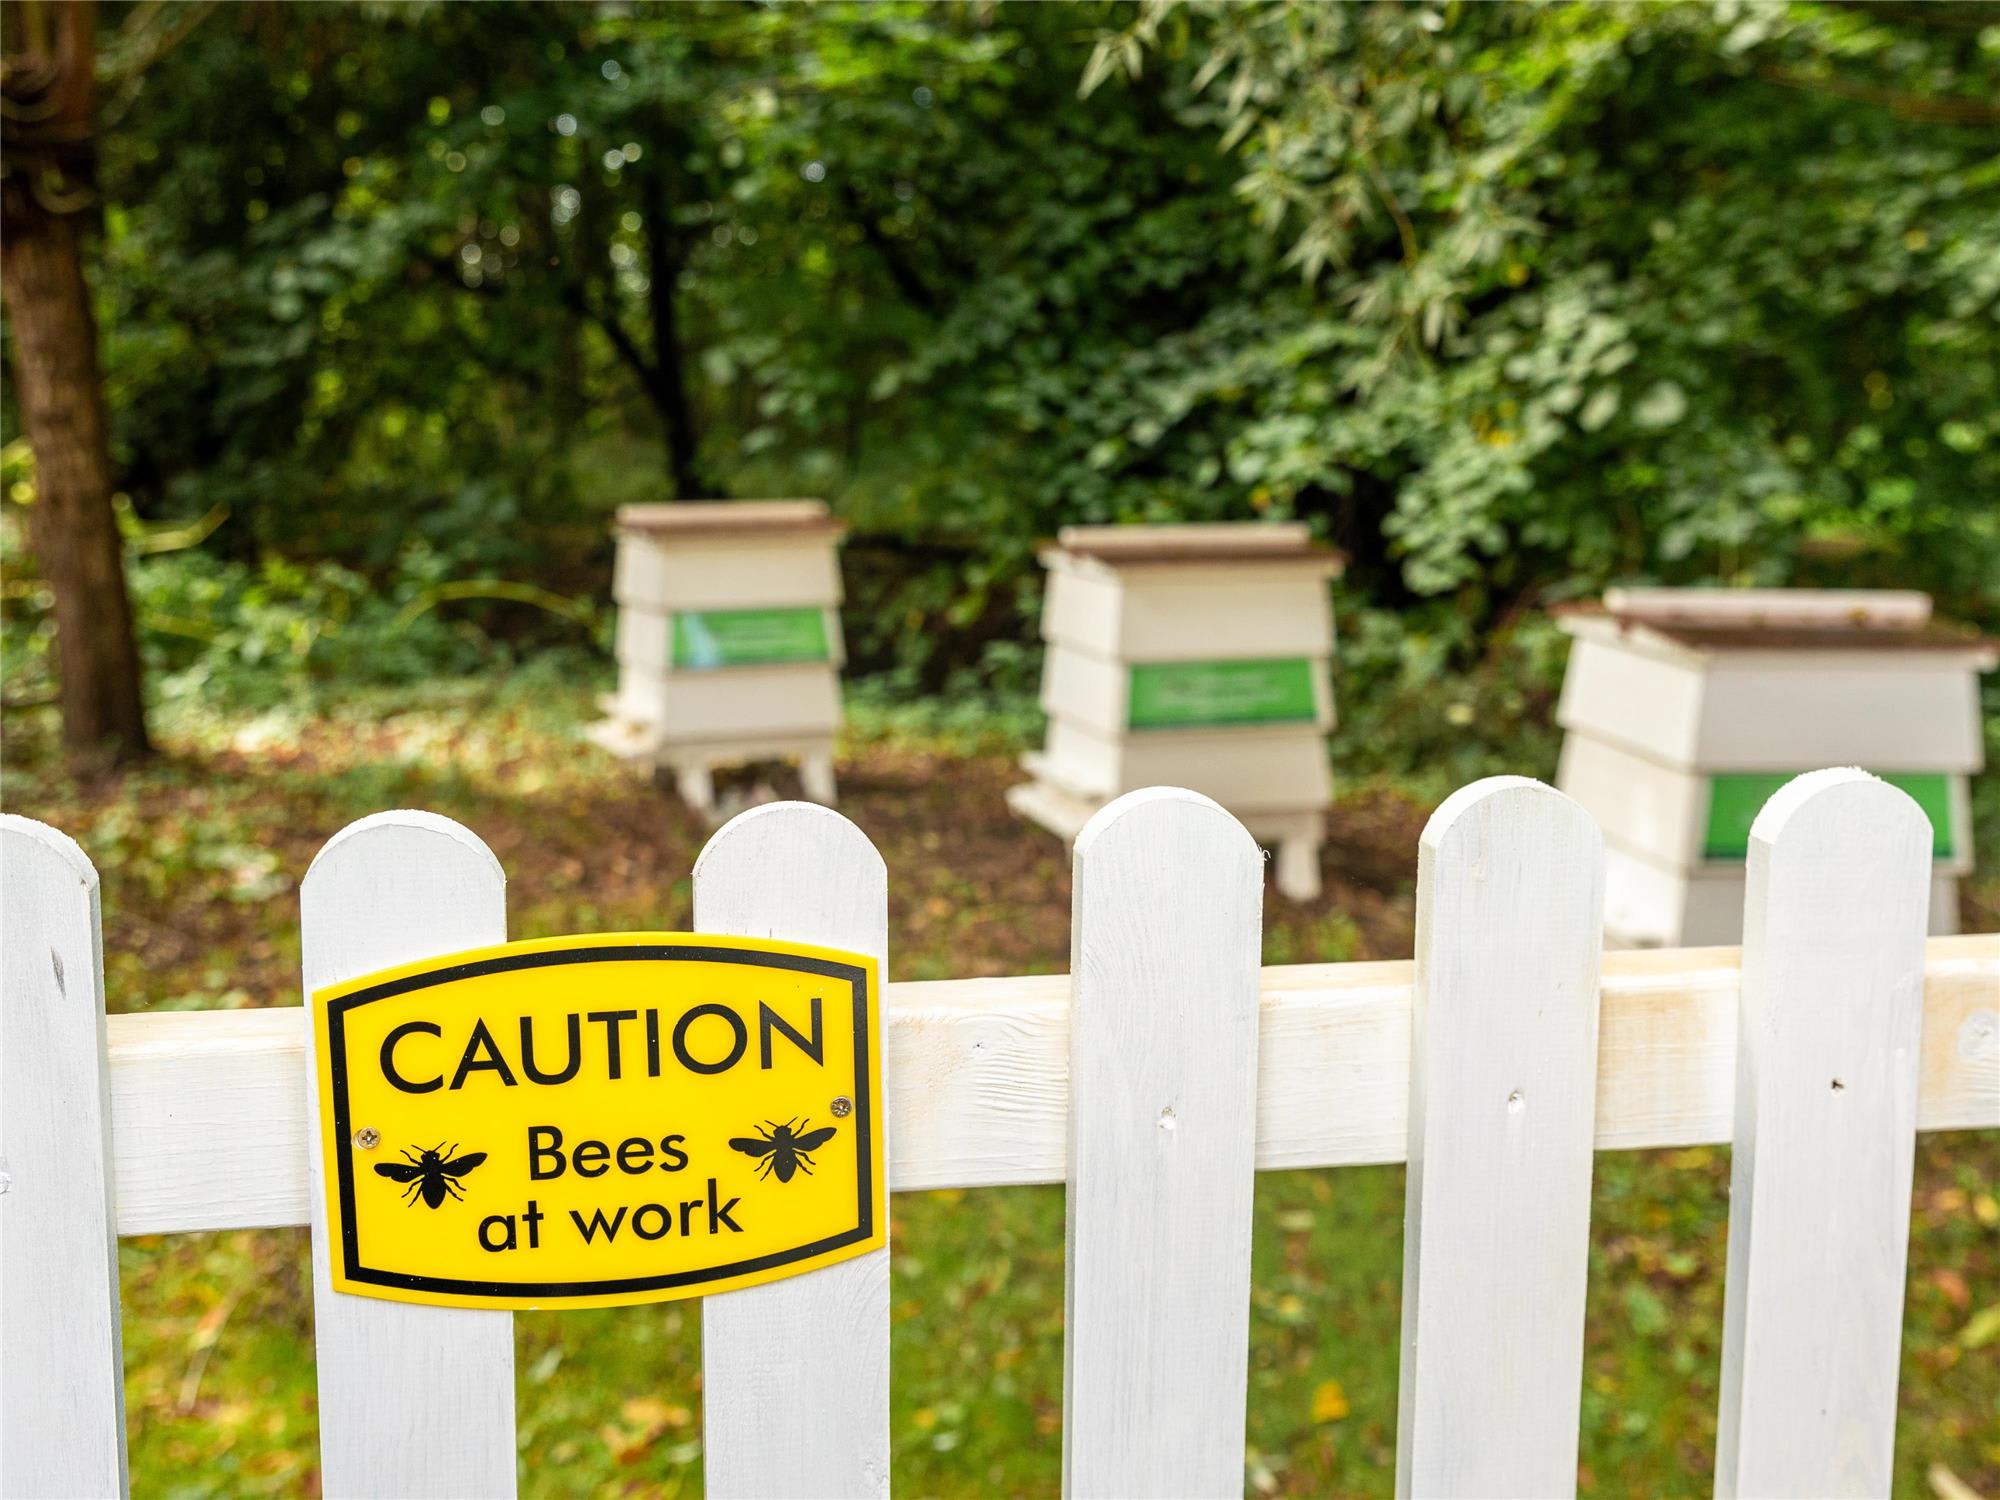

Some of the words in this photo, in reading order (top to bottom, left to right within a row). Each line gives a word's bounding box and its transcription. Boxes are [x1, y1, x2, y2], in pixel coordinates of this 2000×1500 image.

[379, 997, 824, 1094] CAUTION
[528, 1125, 689, 1181] Bees
[477, 1199, 545, 1253] at
[569, 1178, 744, 1245] work
